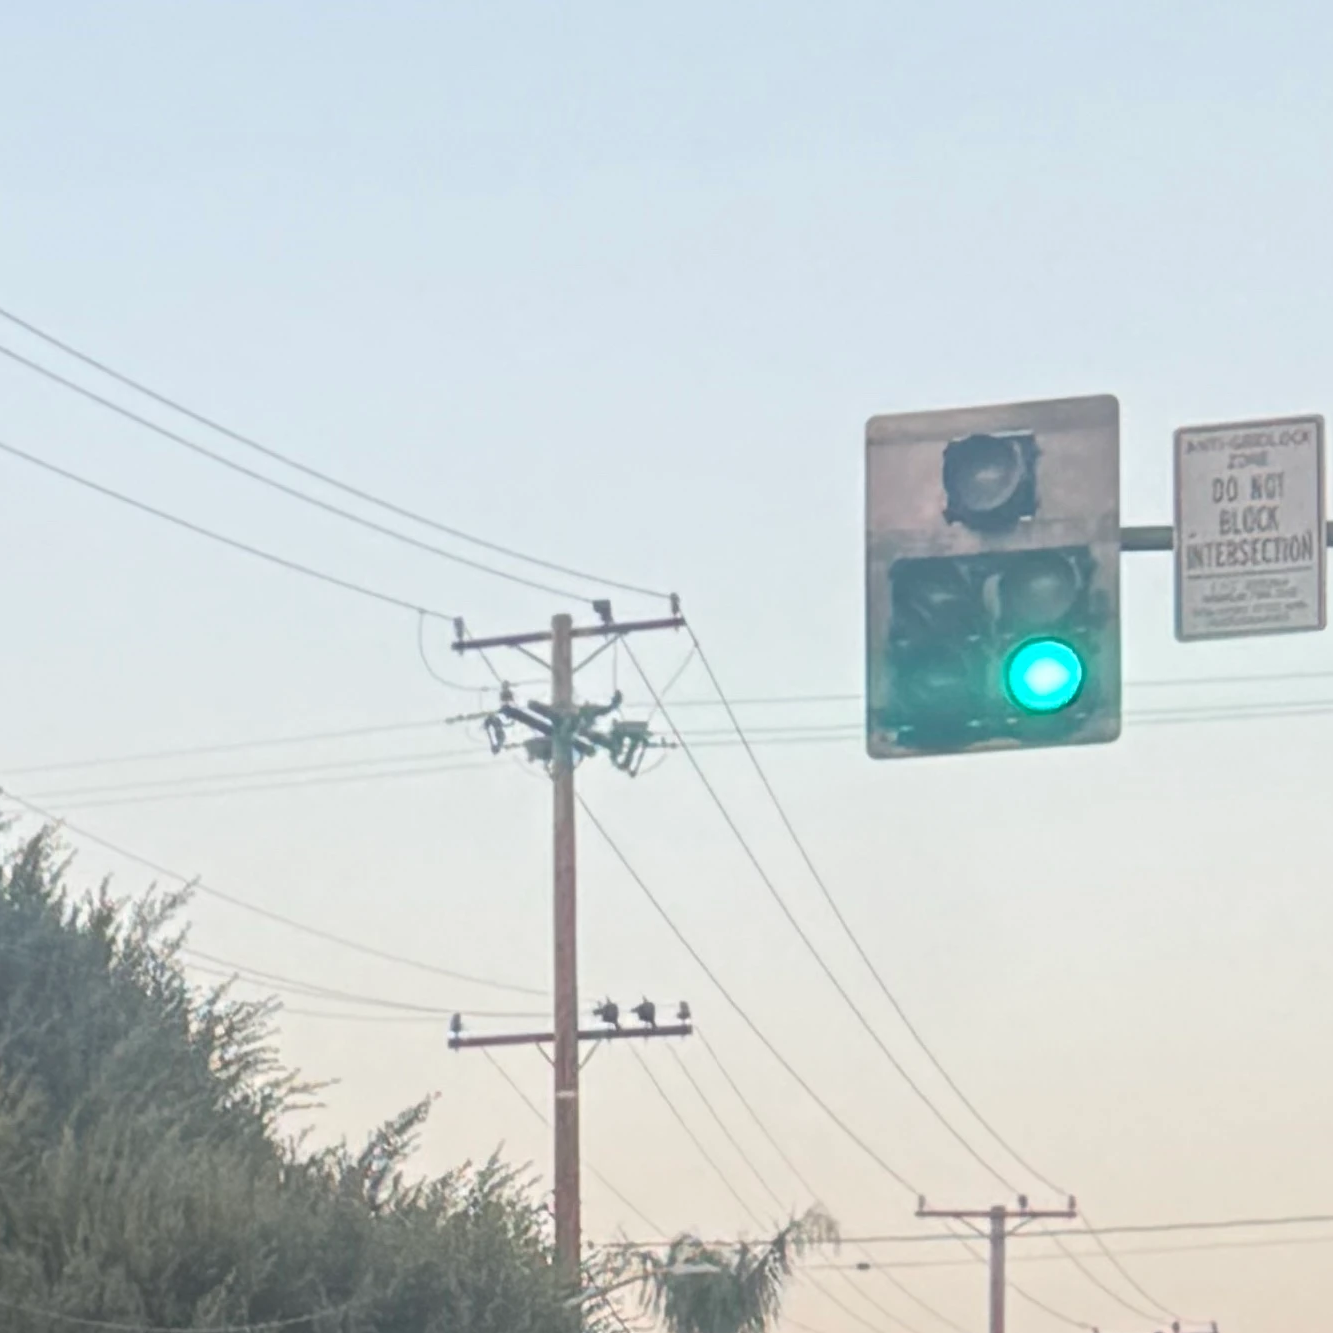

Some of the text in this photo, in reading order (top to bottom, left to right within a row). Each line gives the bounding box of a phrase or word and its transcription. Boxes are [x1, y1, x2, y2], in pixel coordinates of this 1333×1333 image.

[1212, 471, 1284, 504] DO NOT
[1219, 505, 1280, 536] BLOCK
[1186, 529, 1314, 570] INTERSECTION
